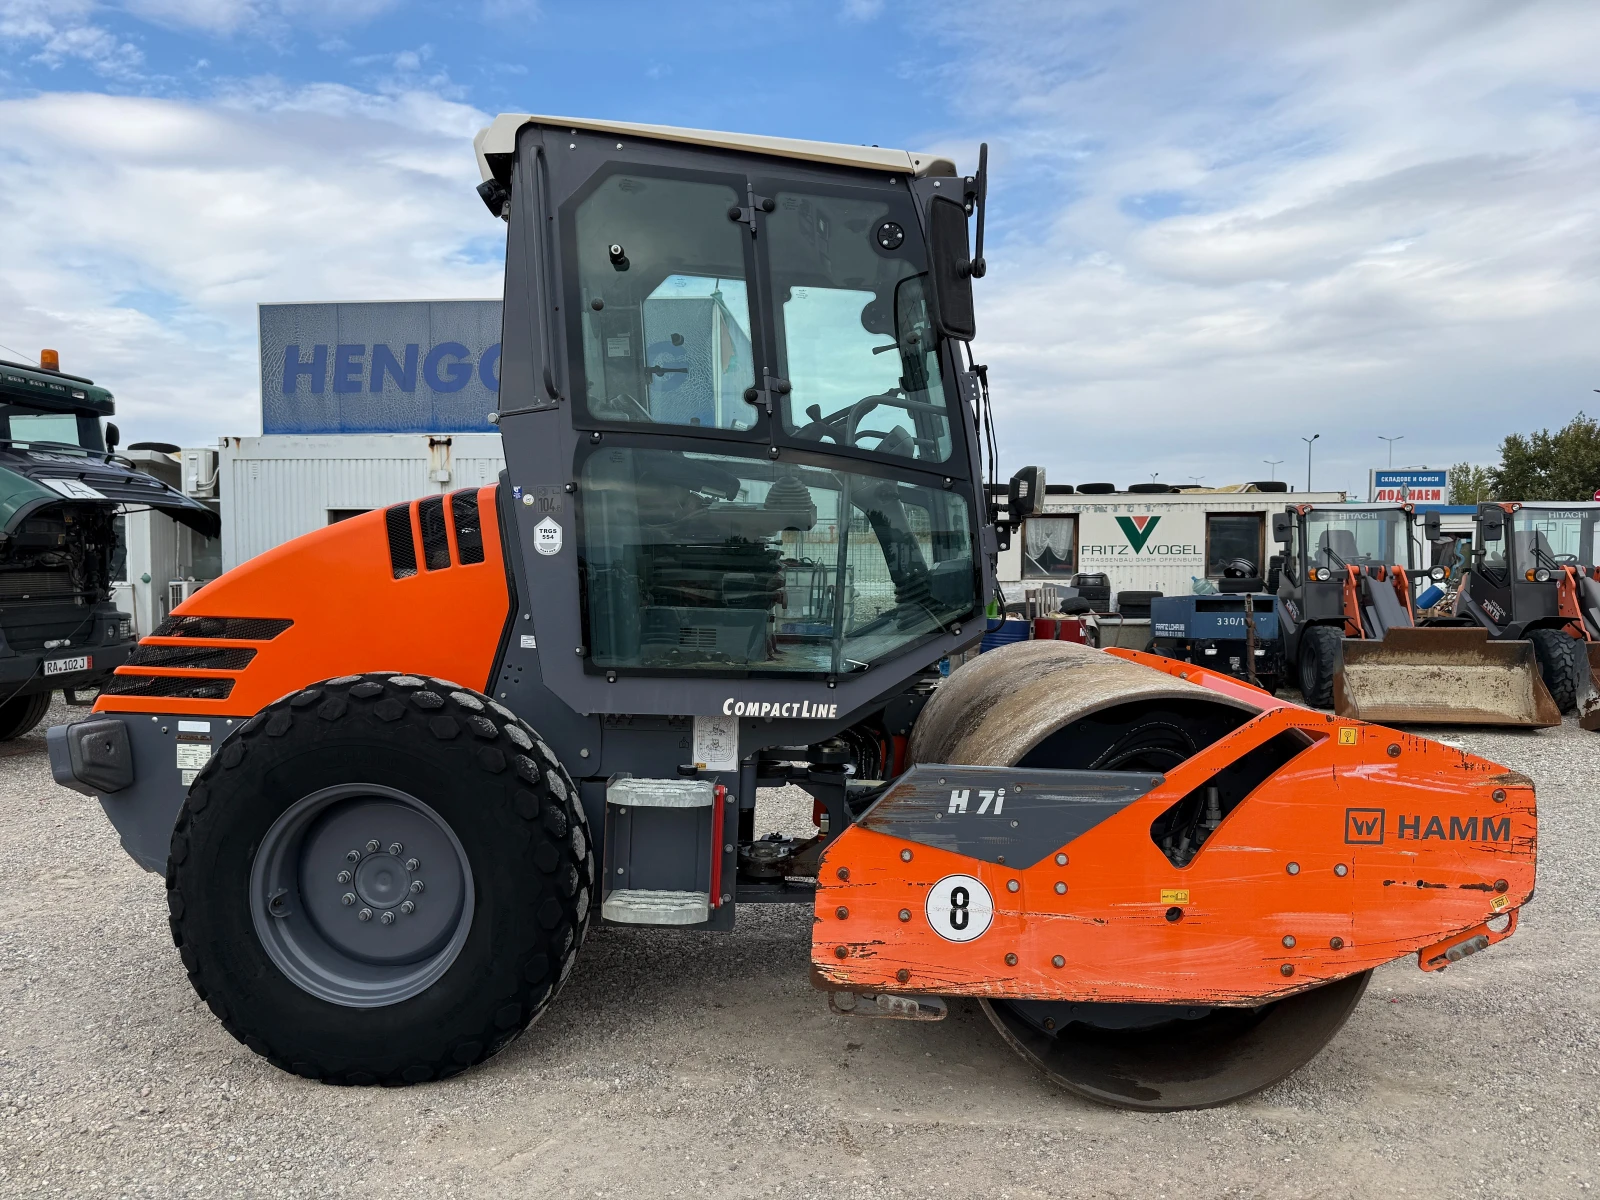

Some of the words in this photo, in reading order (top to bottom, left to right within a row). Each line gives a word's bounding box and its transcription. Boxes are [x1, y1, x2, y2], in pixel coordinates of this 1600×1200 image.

[1379, 490, 1404, 502] ПОД
[1408, 489, 1441, 501] НАЕМ
[1339, 512, 1377, 520] HITACHI
[1548, 511, 1589, 519] HITACHI
[1081, 545, 1128, 555] FRITZ
[1147, 545, 1202, 555] VOGEL
[1483, 599, 1500, 620] ZW75
[47, 662, 58, 673] RA
[63, 659, 78, 671] 102
[79, 658, 85, 669] J
[948, 789, 970, 814] H
[1398, 815, 1511, 841] HAMM
[949, 886, 970, 931] 8
